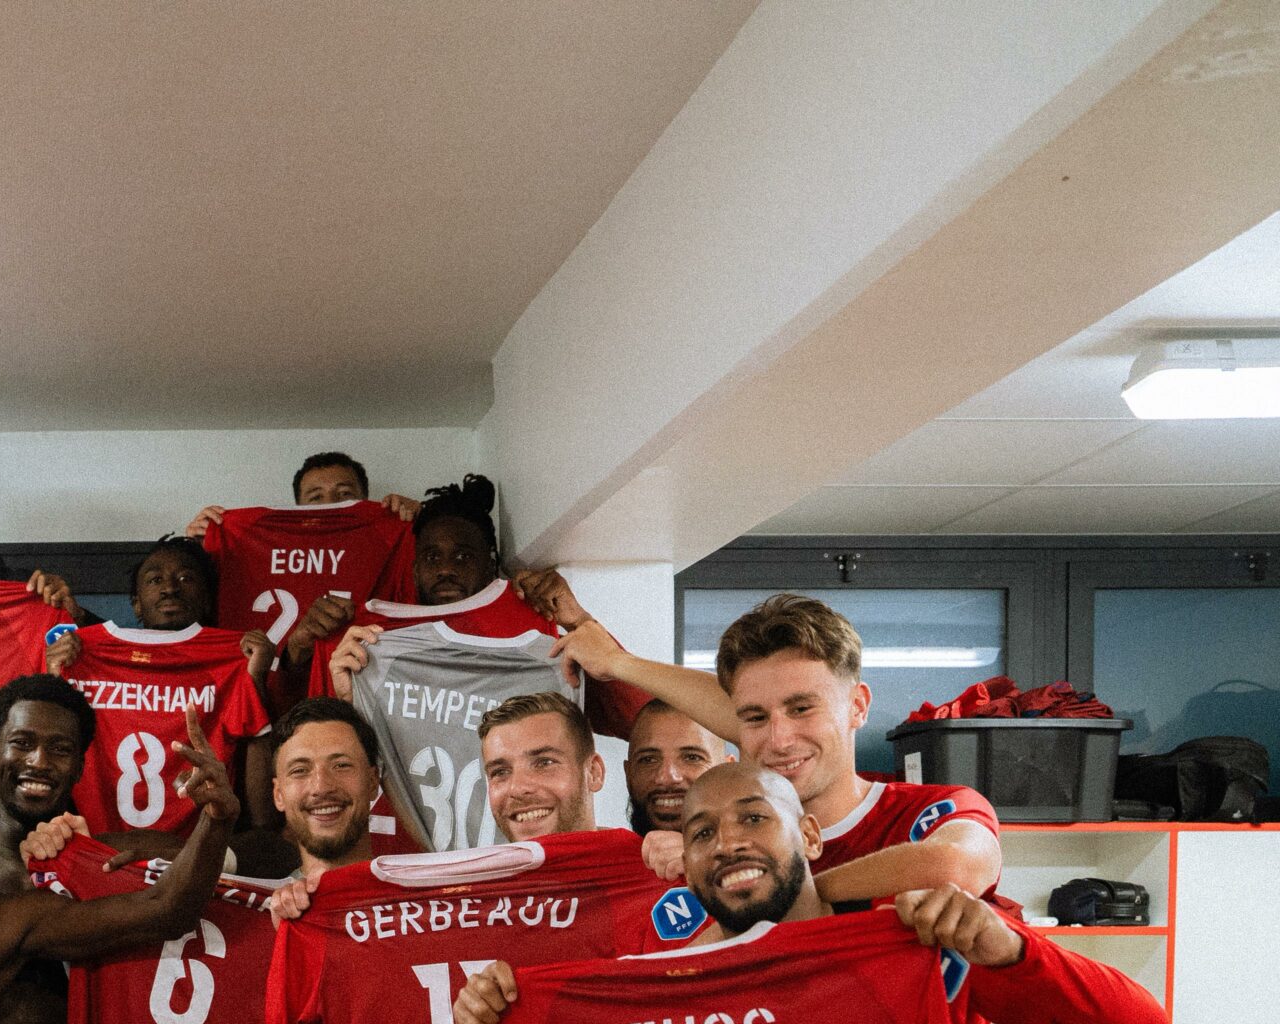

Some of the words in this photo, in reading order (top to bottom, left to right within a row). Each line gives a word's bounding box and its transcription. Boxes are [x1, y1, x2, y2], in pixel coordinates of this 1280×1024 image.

[271, 549, 345, 575] EGNY
[117, 732, 166, 828] 8
[663, 894, 692, 926] N
